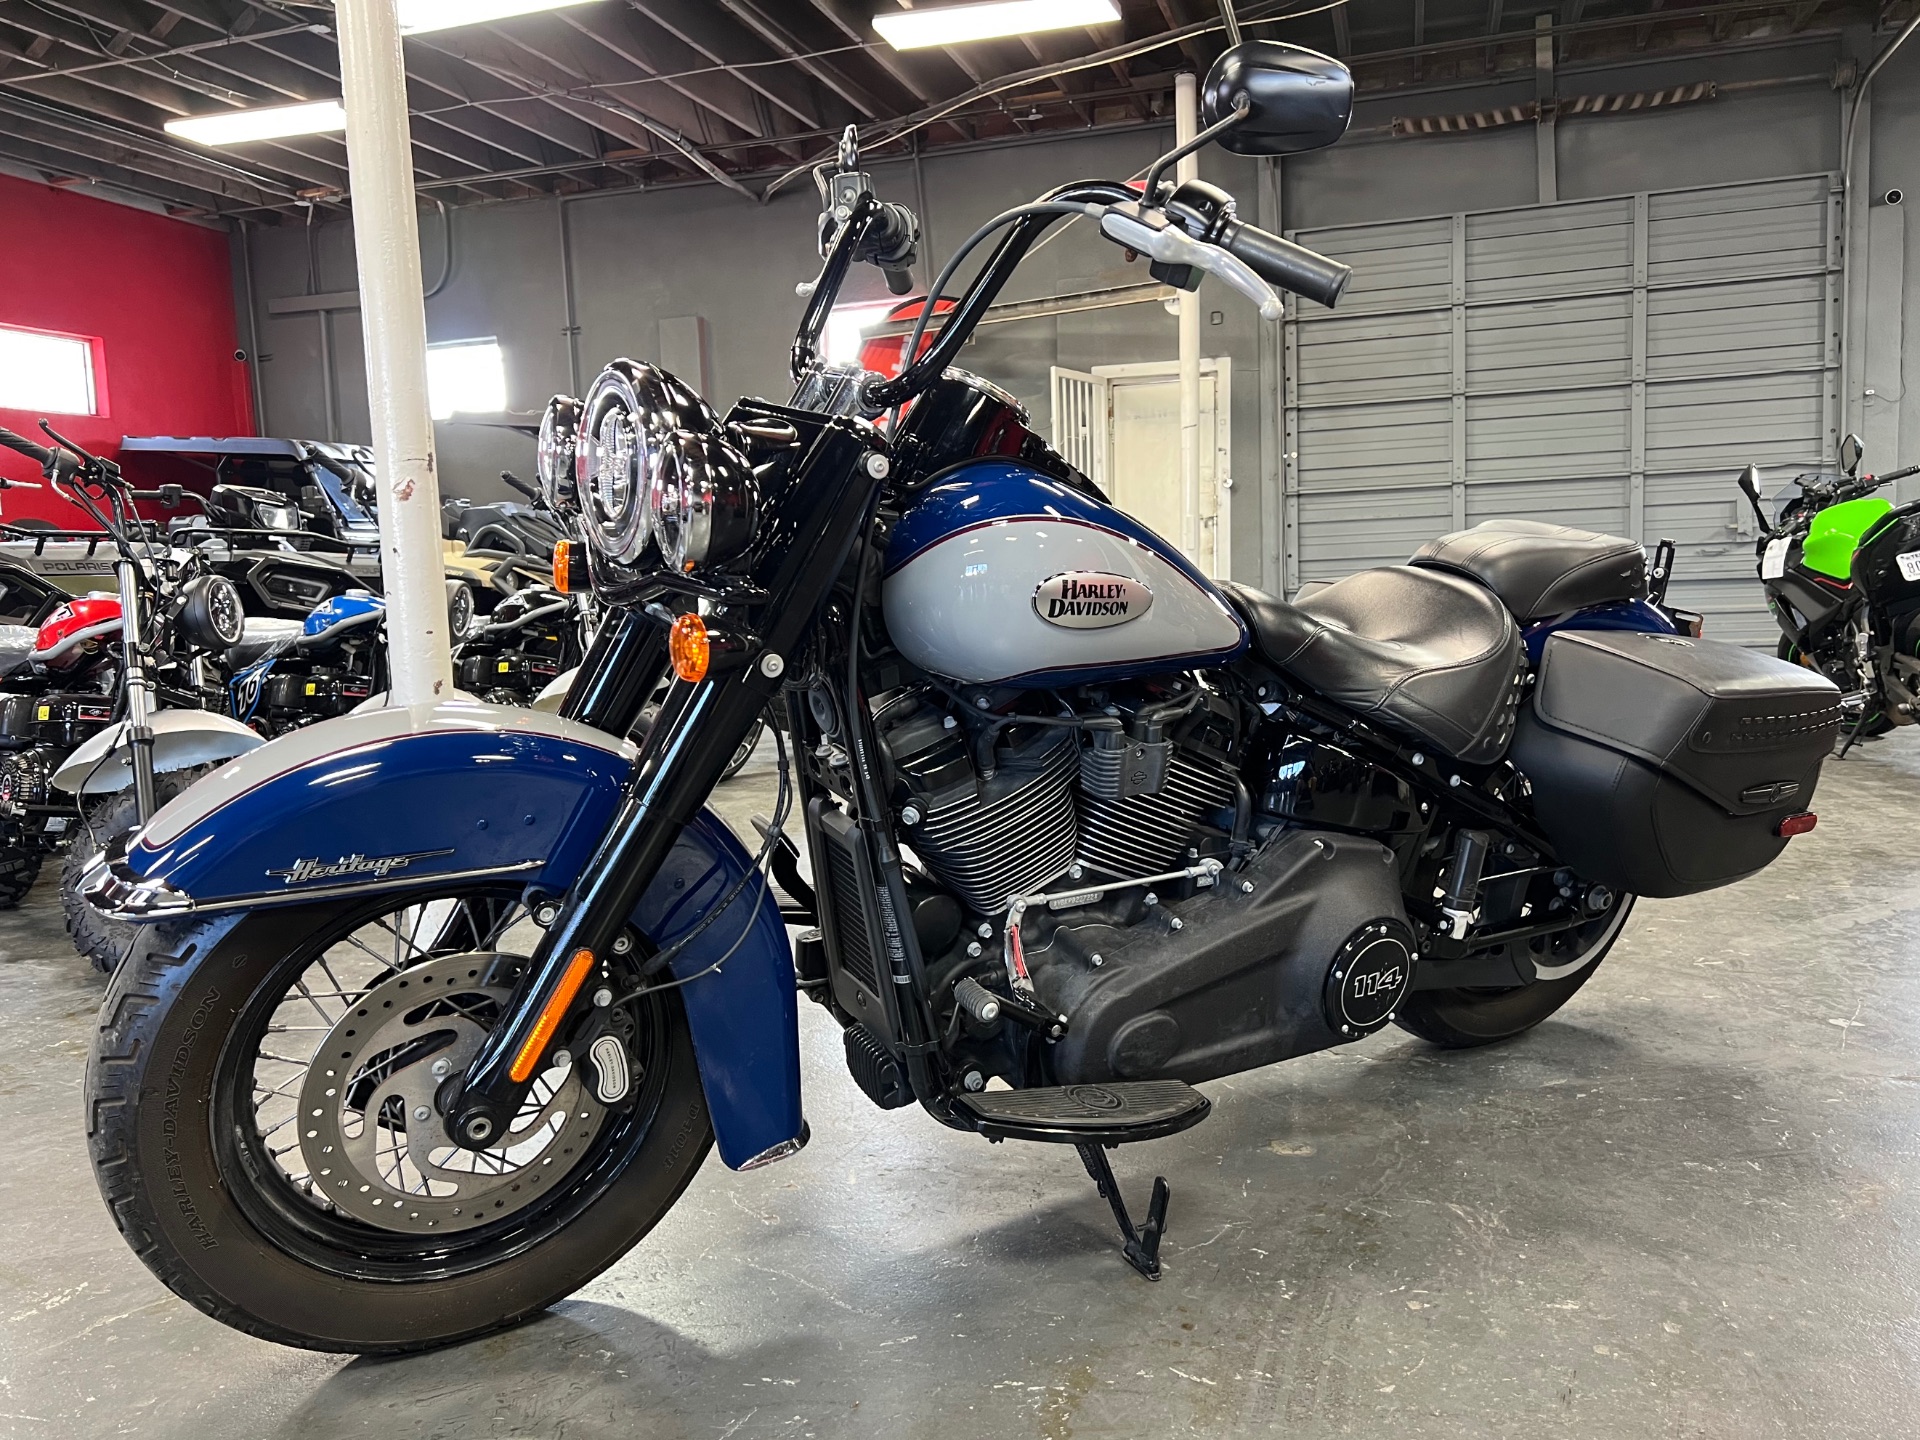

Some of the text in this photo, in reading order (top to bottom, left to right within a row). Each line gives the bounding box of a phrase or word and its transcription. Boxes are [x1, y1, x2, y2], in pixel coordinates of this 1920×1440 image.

[43, 562, 112, 571] POLARIS
[1048, 598, 1128, 618] DAVIDSON
[284, 853, 410, 884] Heritage
[1354, 965, 1403, 998] 114
[163, 986, 221, 1251] HARLEY-DAVIDSON
